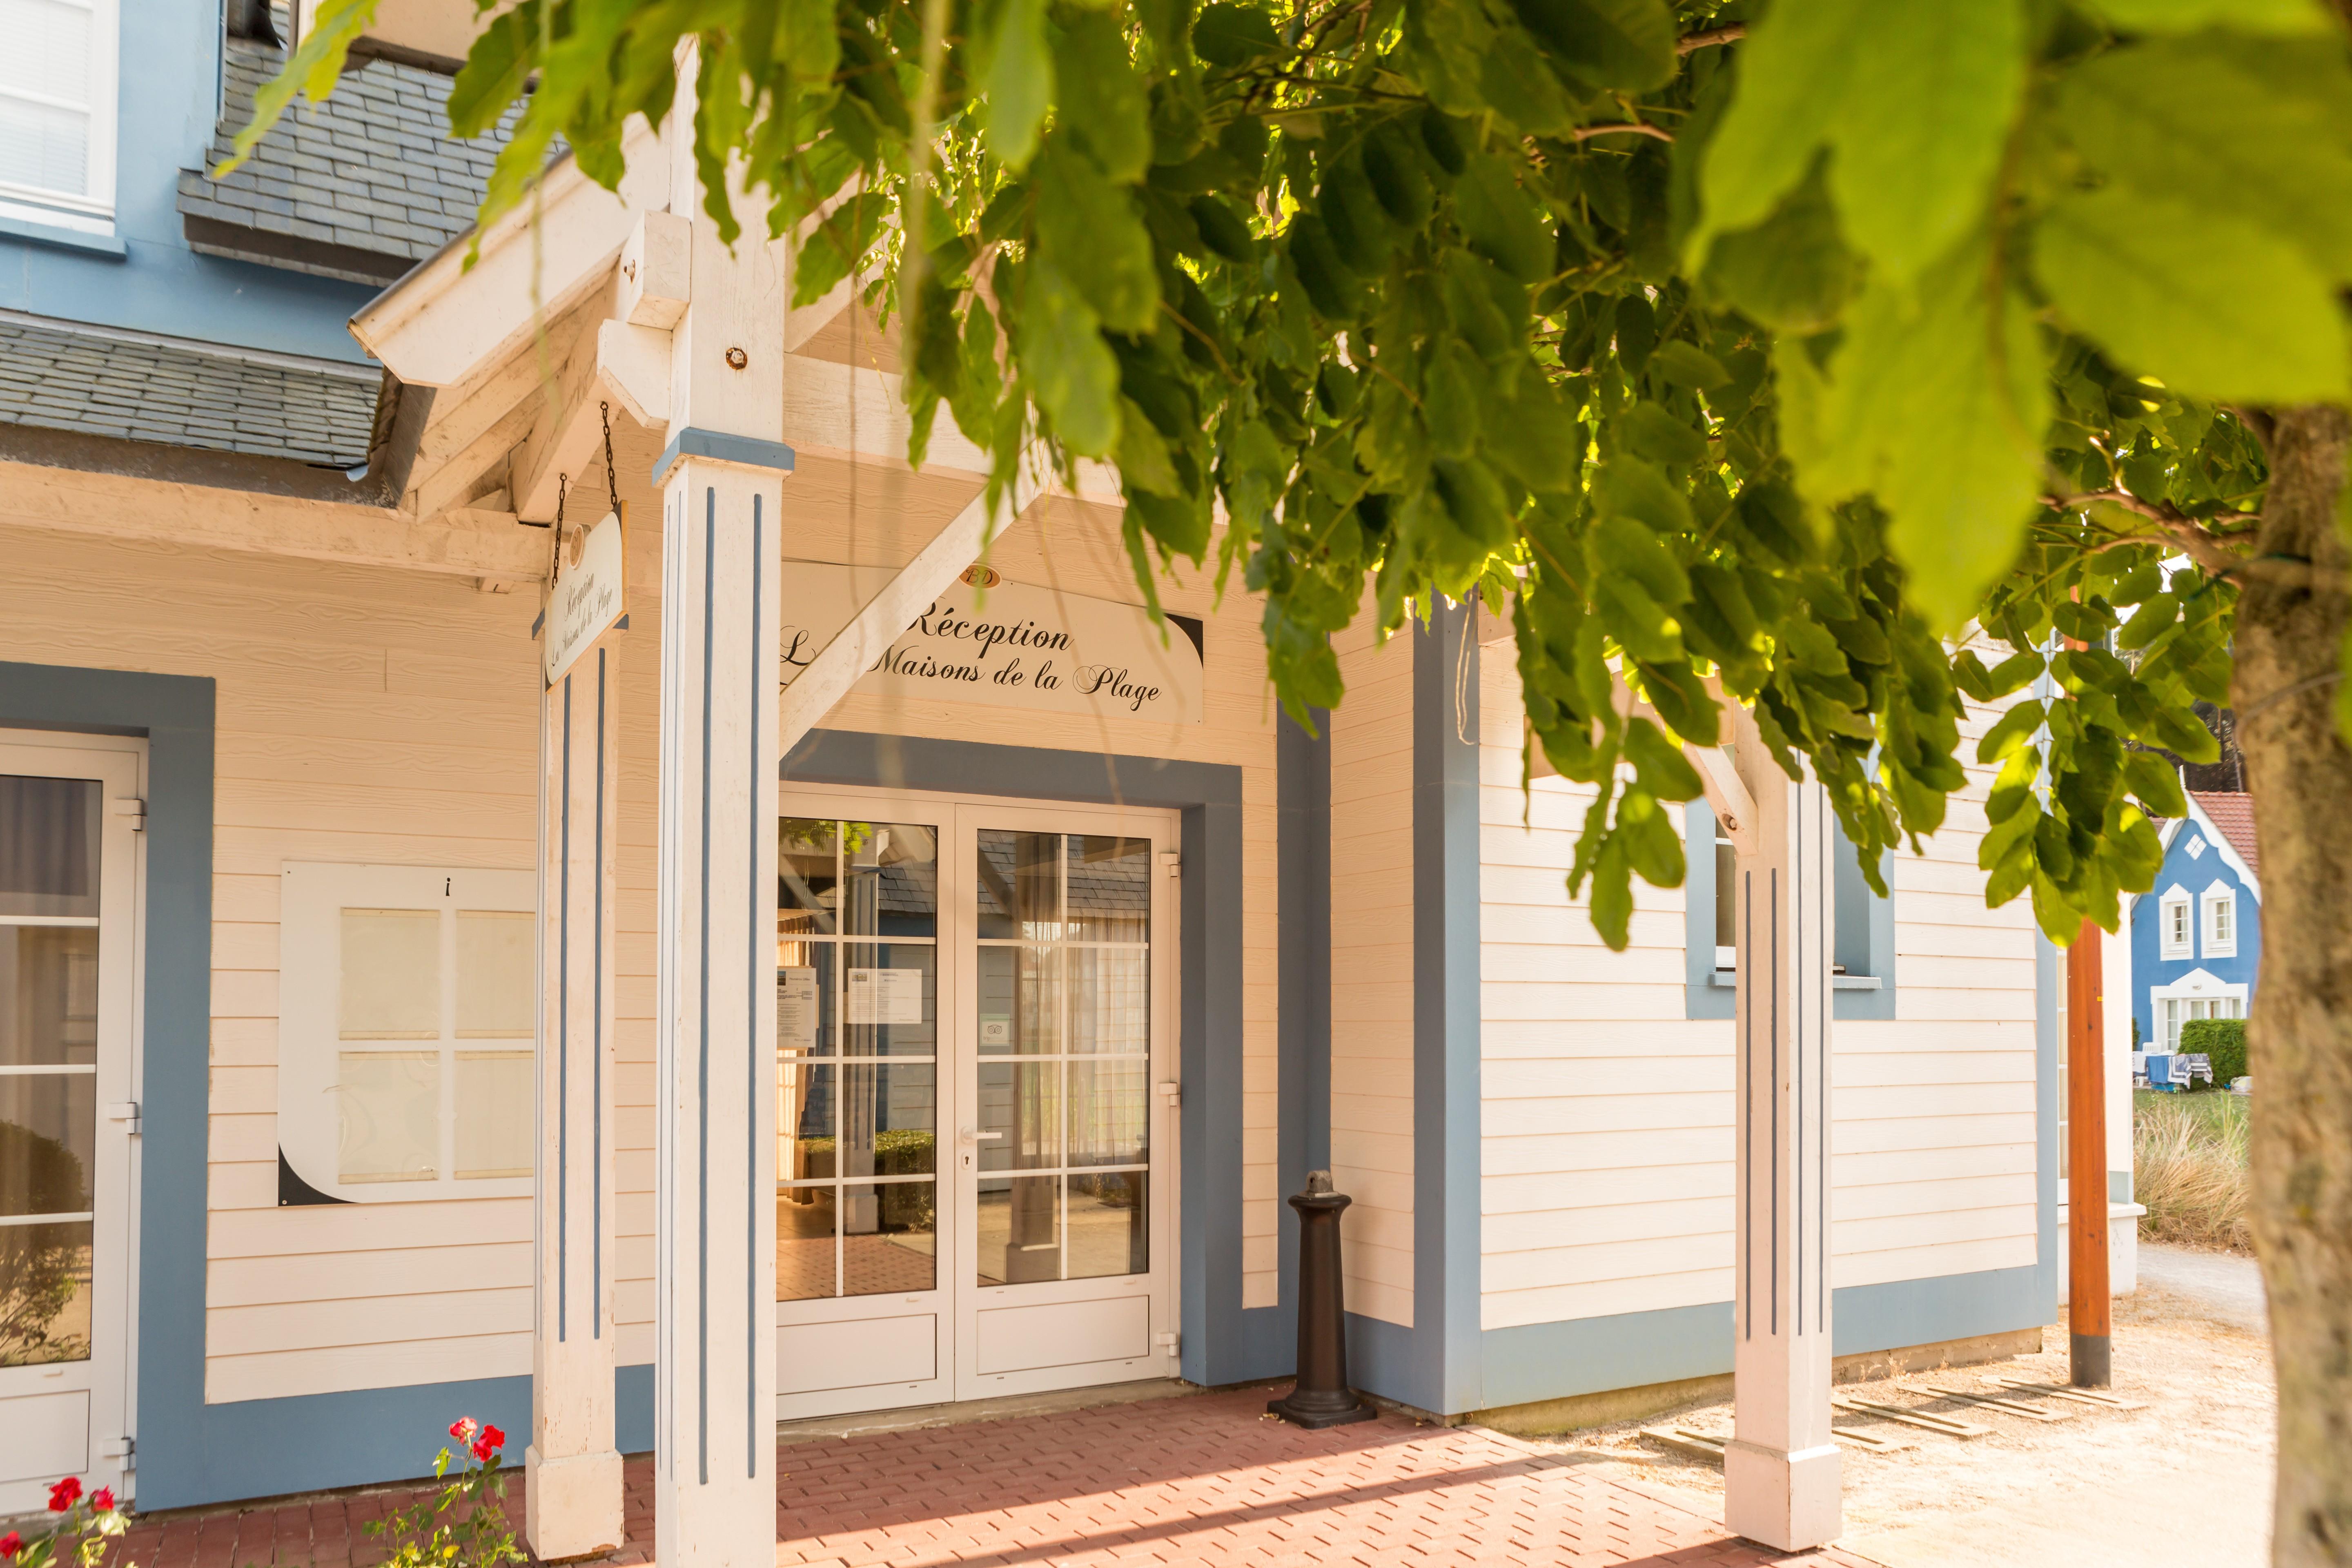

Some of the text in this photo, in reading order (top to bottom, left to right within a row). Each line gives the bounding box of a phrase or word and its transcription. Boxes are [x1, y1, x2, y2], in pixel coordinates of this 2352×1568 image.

[564, 573, 594, 621] Réception
[581, 608, 586, 634] de
[588, 600, 592, 626] la
[595, 582, 612, 618] Plage
[906, 596, 1075, 659] Réception
[866, 644, 1162, 711] Maisons de la Plage
